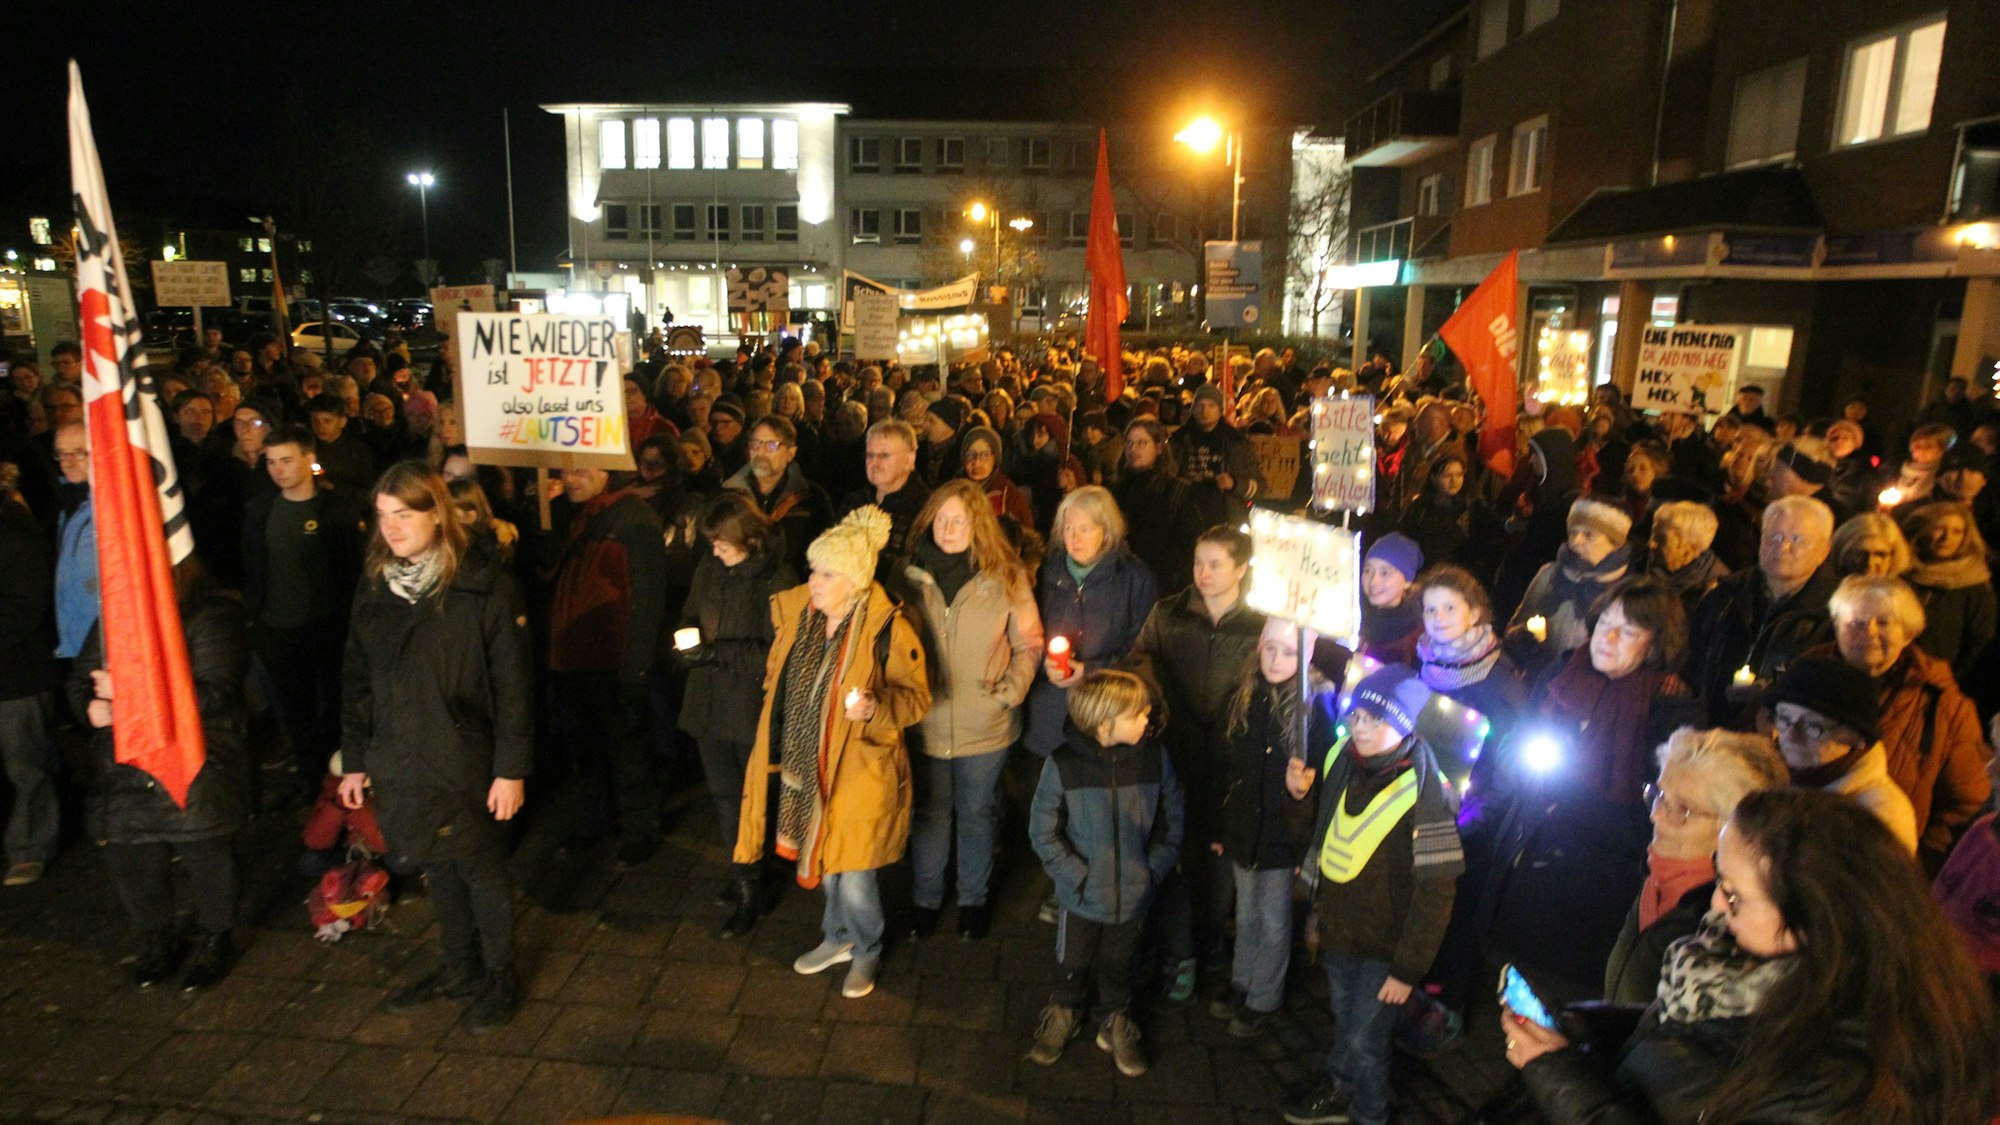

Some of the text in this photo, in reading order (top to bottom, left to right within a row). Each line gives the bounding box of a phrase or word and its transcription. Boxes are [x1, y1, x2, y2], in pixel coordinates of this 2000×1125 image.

[472, 318, 616, 360] NIE WIEDER
[487, 362, 509, 385] ist
[502, 396, 604, 415] also lasst uns
[1316, 402, 1369, 433] Bitte
[499, 416, 624, 447] #LAUTSEIN
